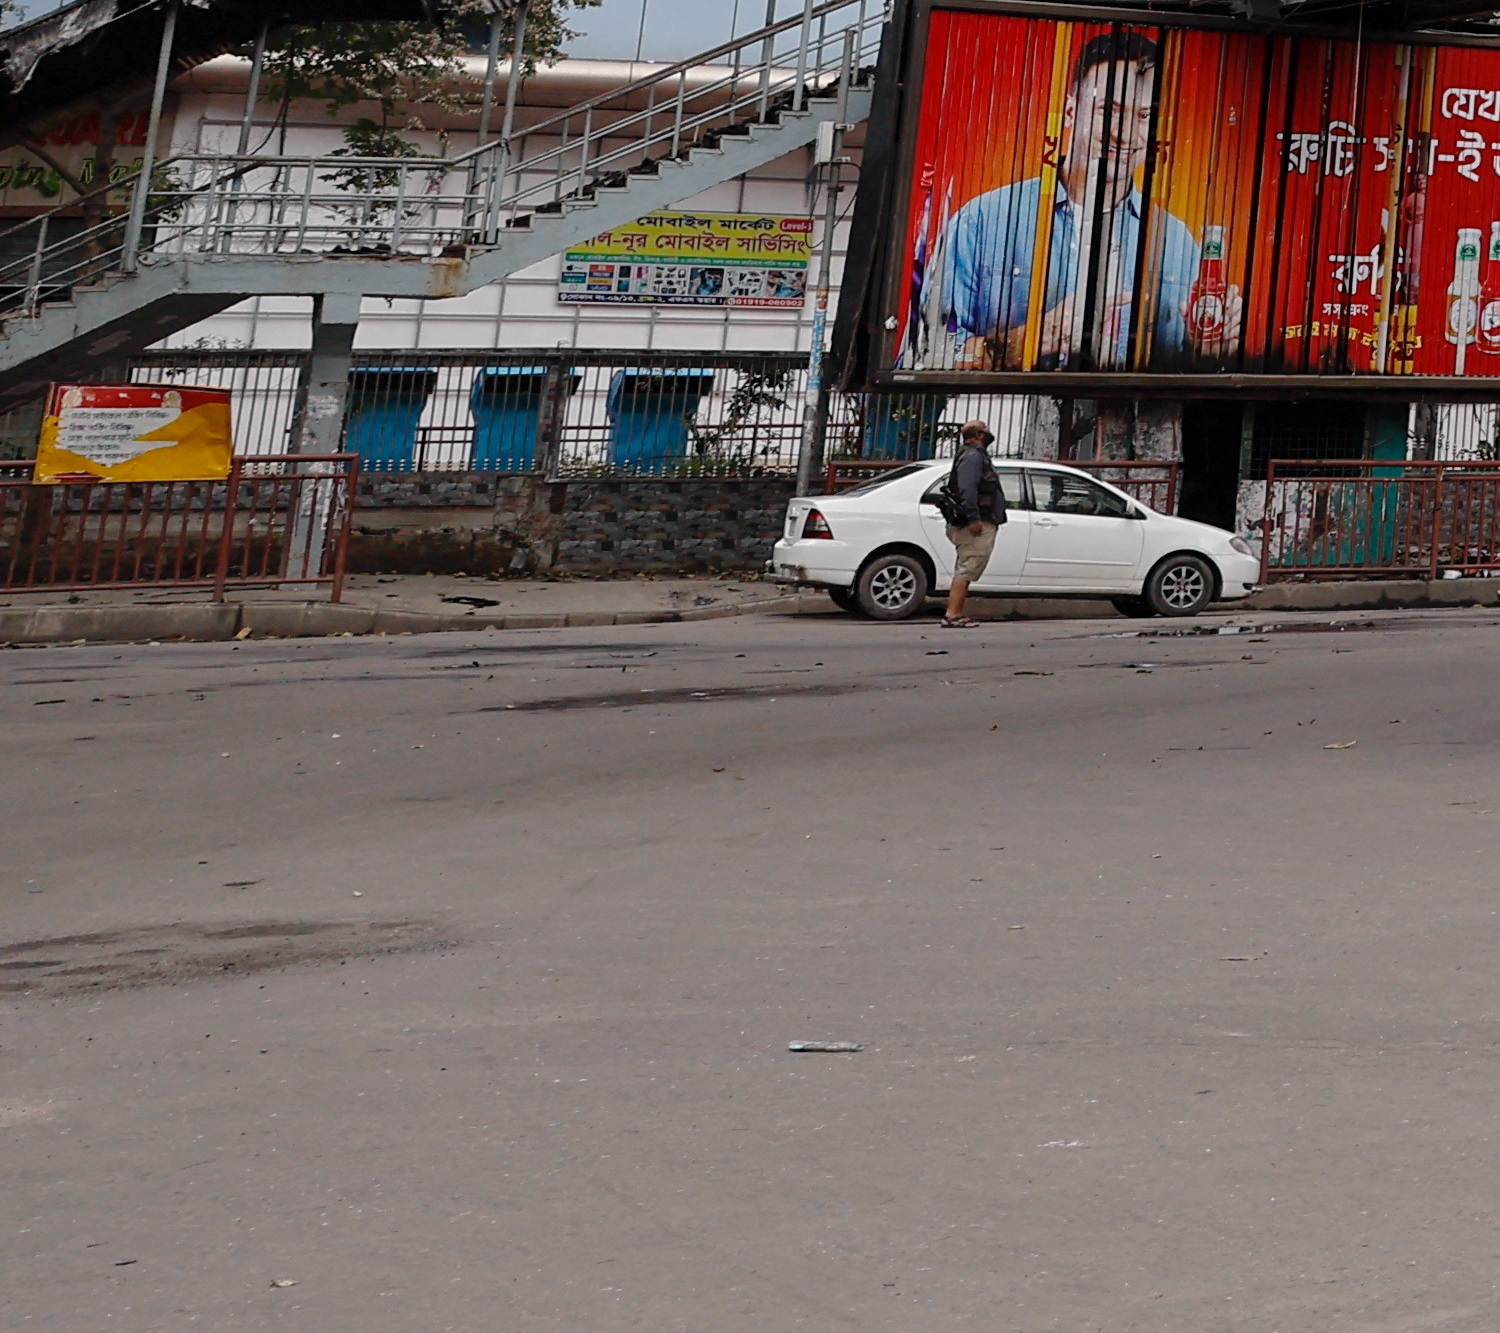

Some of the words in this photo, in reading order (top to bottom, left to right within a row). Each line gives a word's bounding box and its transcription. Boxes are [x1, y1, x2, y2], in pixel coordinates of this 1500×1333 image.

[1276, 120, 1367, 177] রুচি
[655, 232, 730, 252] মোবাইল
[738, 233, 807, 255] সার্ভিসিং
